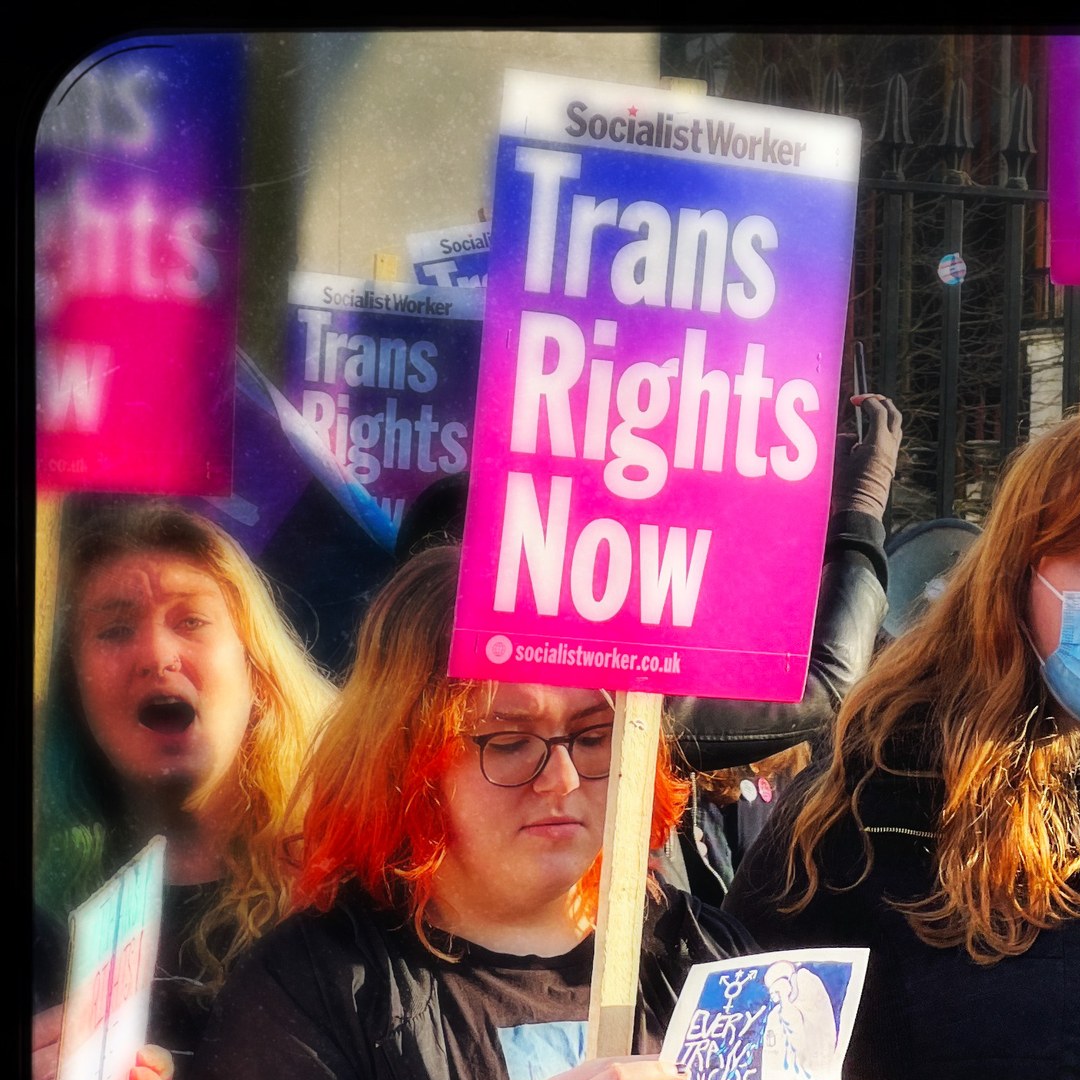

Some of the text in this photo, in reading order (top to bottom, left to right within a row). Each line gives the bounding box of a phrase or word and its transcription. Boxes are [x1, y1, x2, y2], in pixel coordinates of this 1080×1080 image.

[514, 146, 779, 320] Trans
[297, 308, 438, 393] Trans
[301, 390, 469, 485] Rights
[510, 311, 820, 500] Rights
[493, 472, 712, 628] Now
[515, 641, 682, 674] socialistworker.co.uk
[686, 1005, 767, 1045] EVERY
